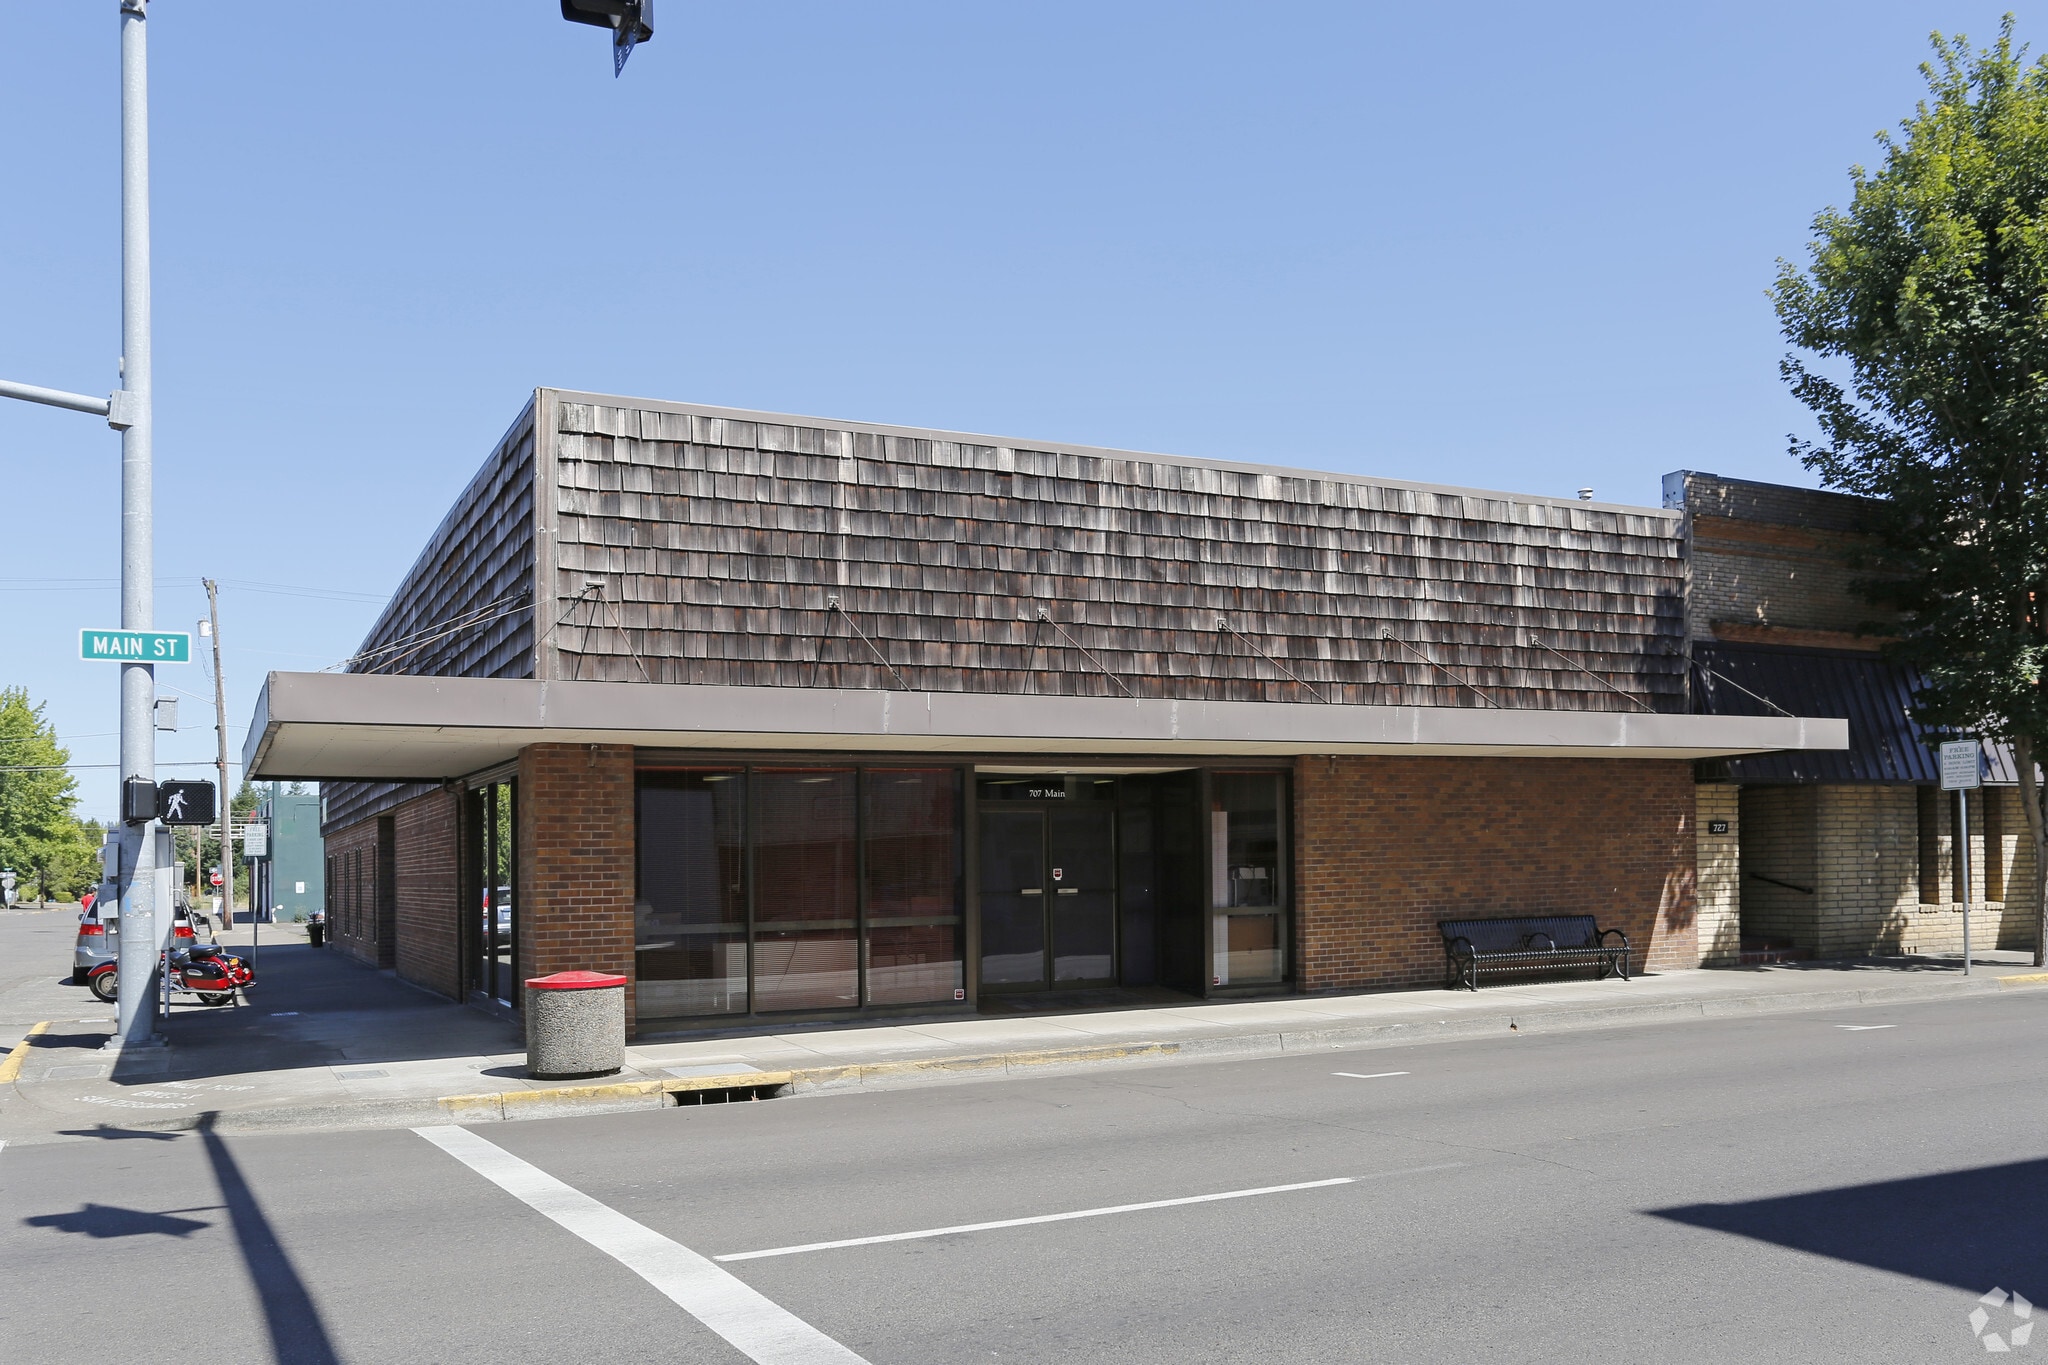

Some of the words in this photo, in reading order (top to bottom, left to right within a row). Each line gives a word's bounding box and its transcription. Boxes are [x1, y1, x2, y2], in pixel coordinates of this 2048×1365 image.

[93, 636, 143, 655] MAIN
[153, 638, 178, 657] ST
[1949, 746, 1970, 754] FREE
[1029, 789, 1042, 798] 707
[1044, 789, 1066, 798] Main
[1713, 823, 1726, 832] 727
